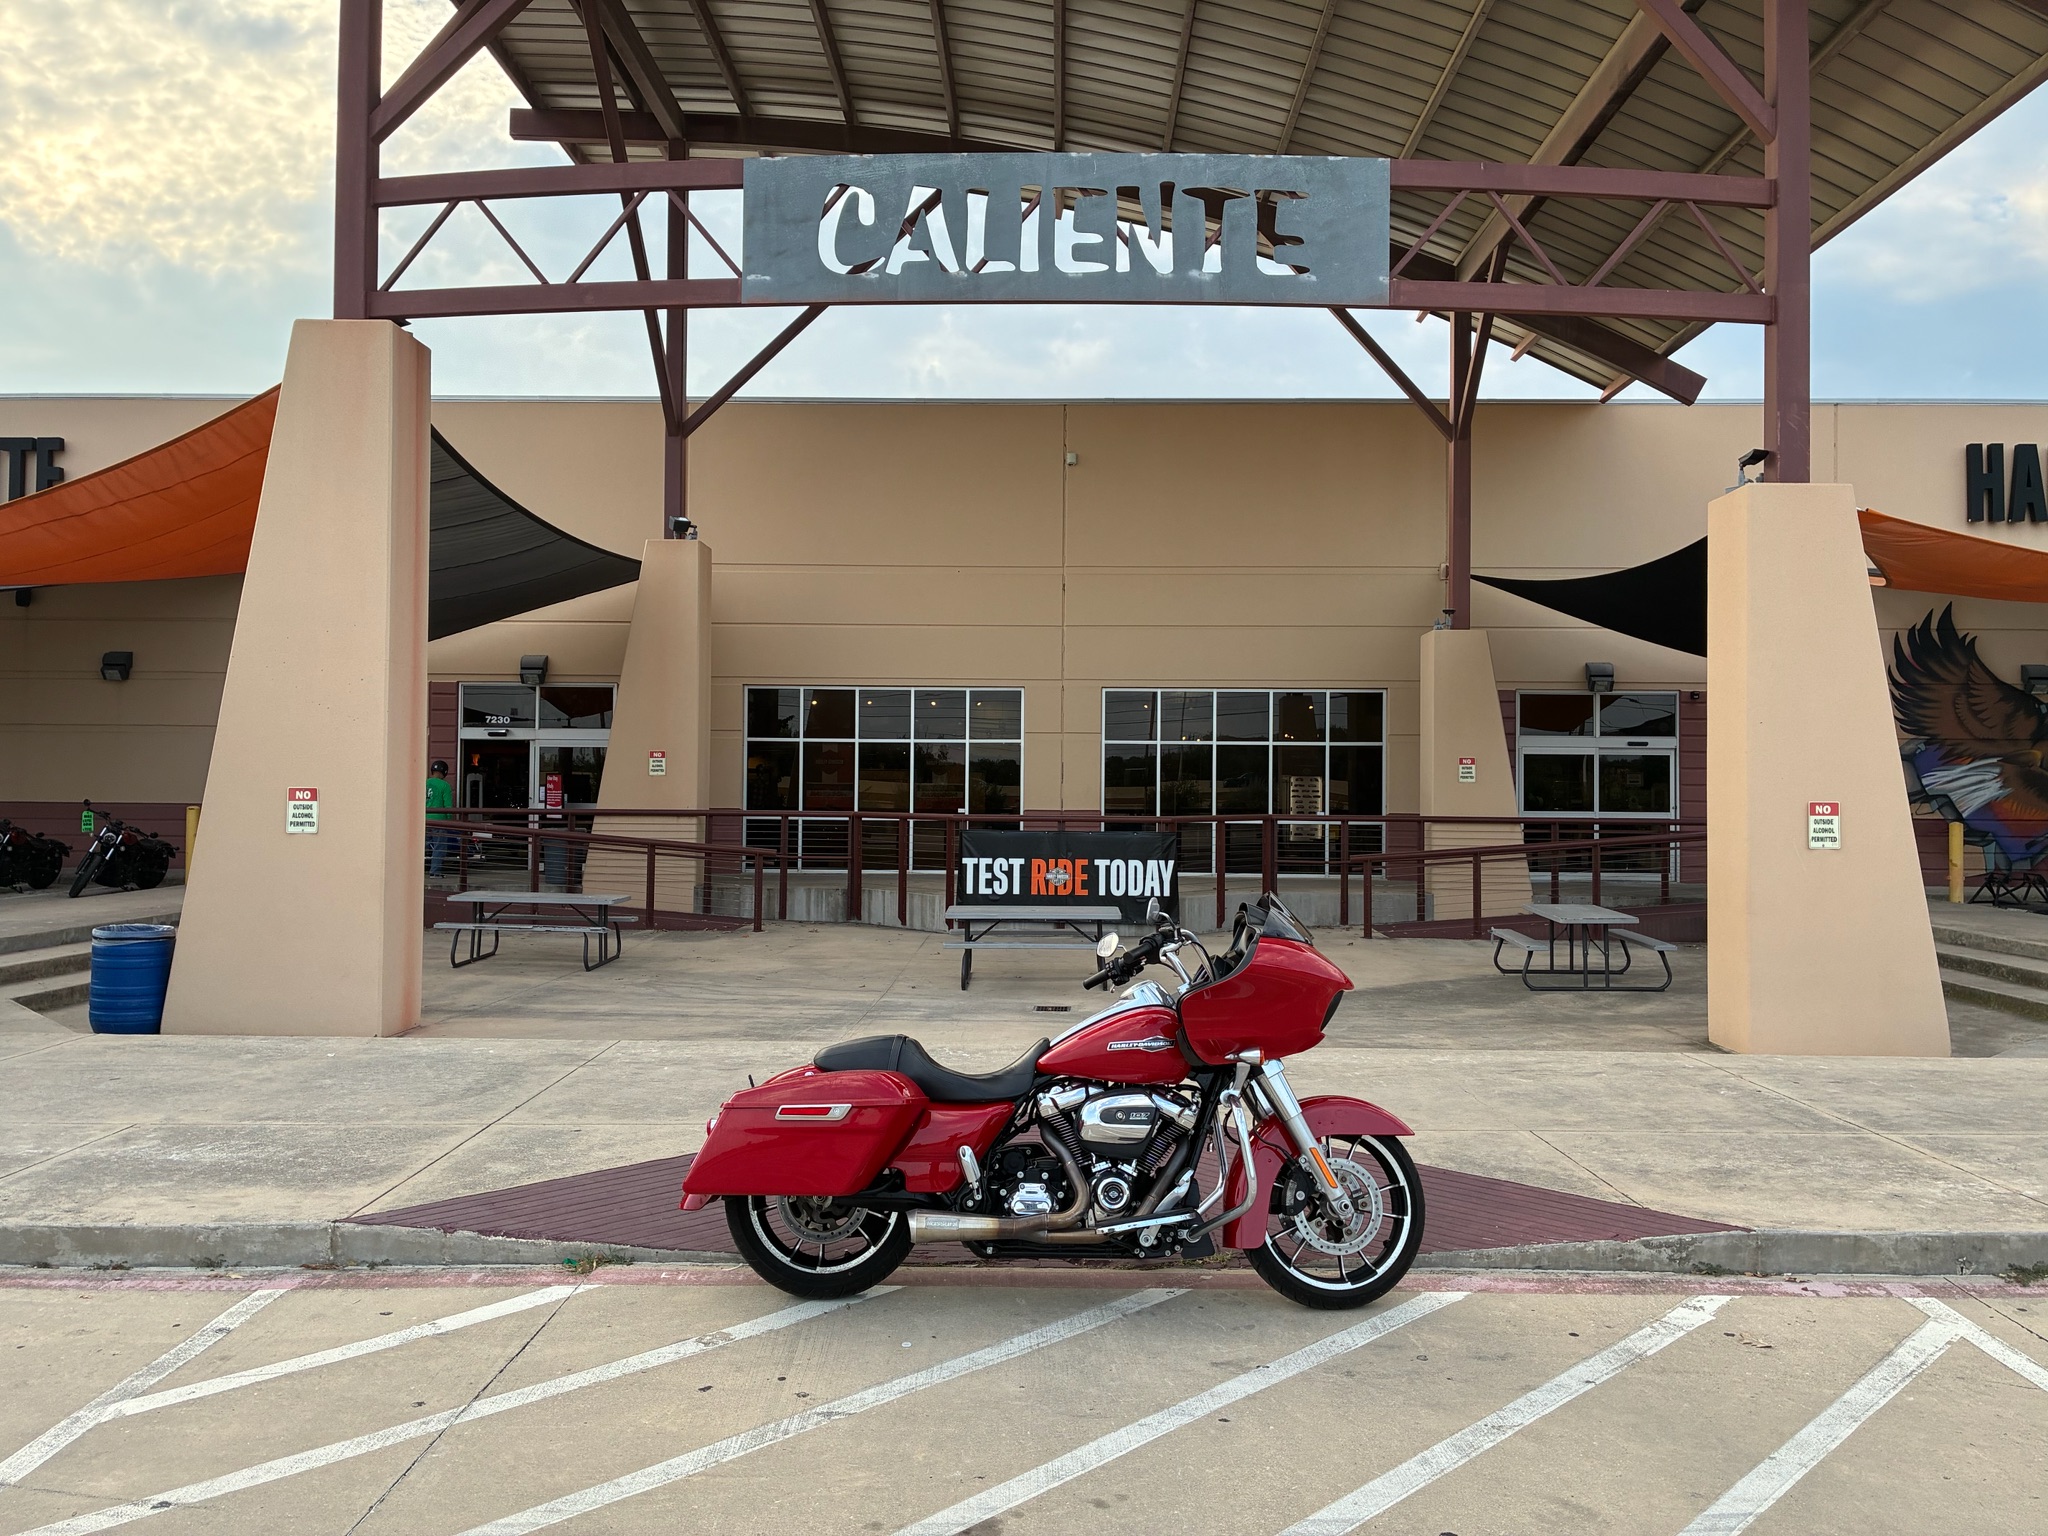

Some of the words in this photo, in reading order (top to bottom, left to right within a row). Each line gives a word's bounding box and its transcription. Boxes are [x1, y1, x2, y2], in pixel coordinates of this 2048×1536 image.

[817, 181, 1310, 275] CALIENTE
[1966, 443, 2048, 522] HA
[485, 716, 511, 724] 7230
[295, 790, 312, 800] NO
[1815, 805, 1832, 815] NO
[962, 857, 1025, 895] TEST
[1031, 858, 1089, 896] RIDE
[1094, 858, 1175, 897] TODAY
